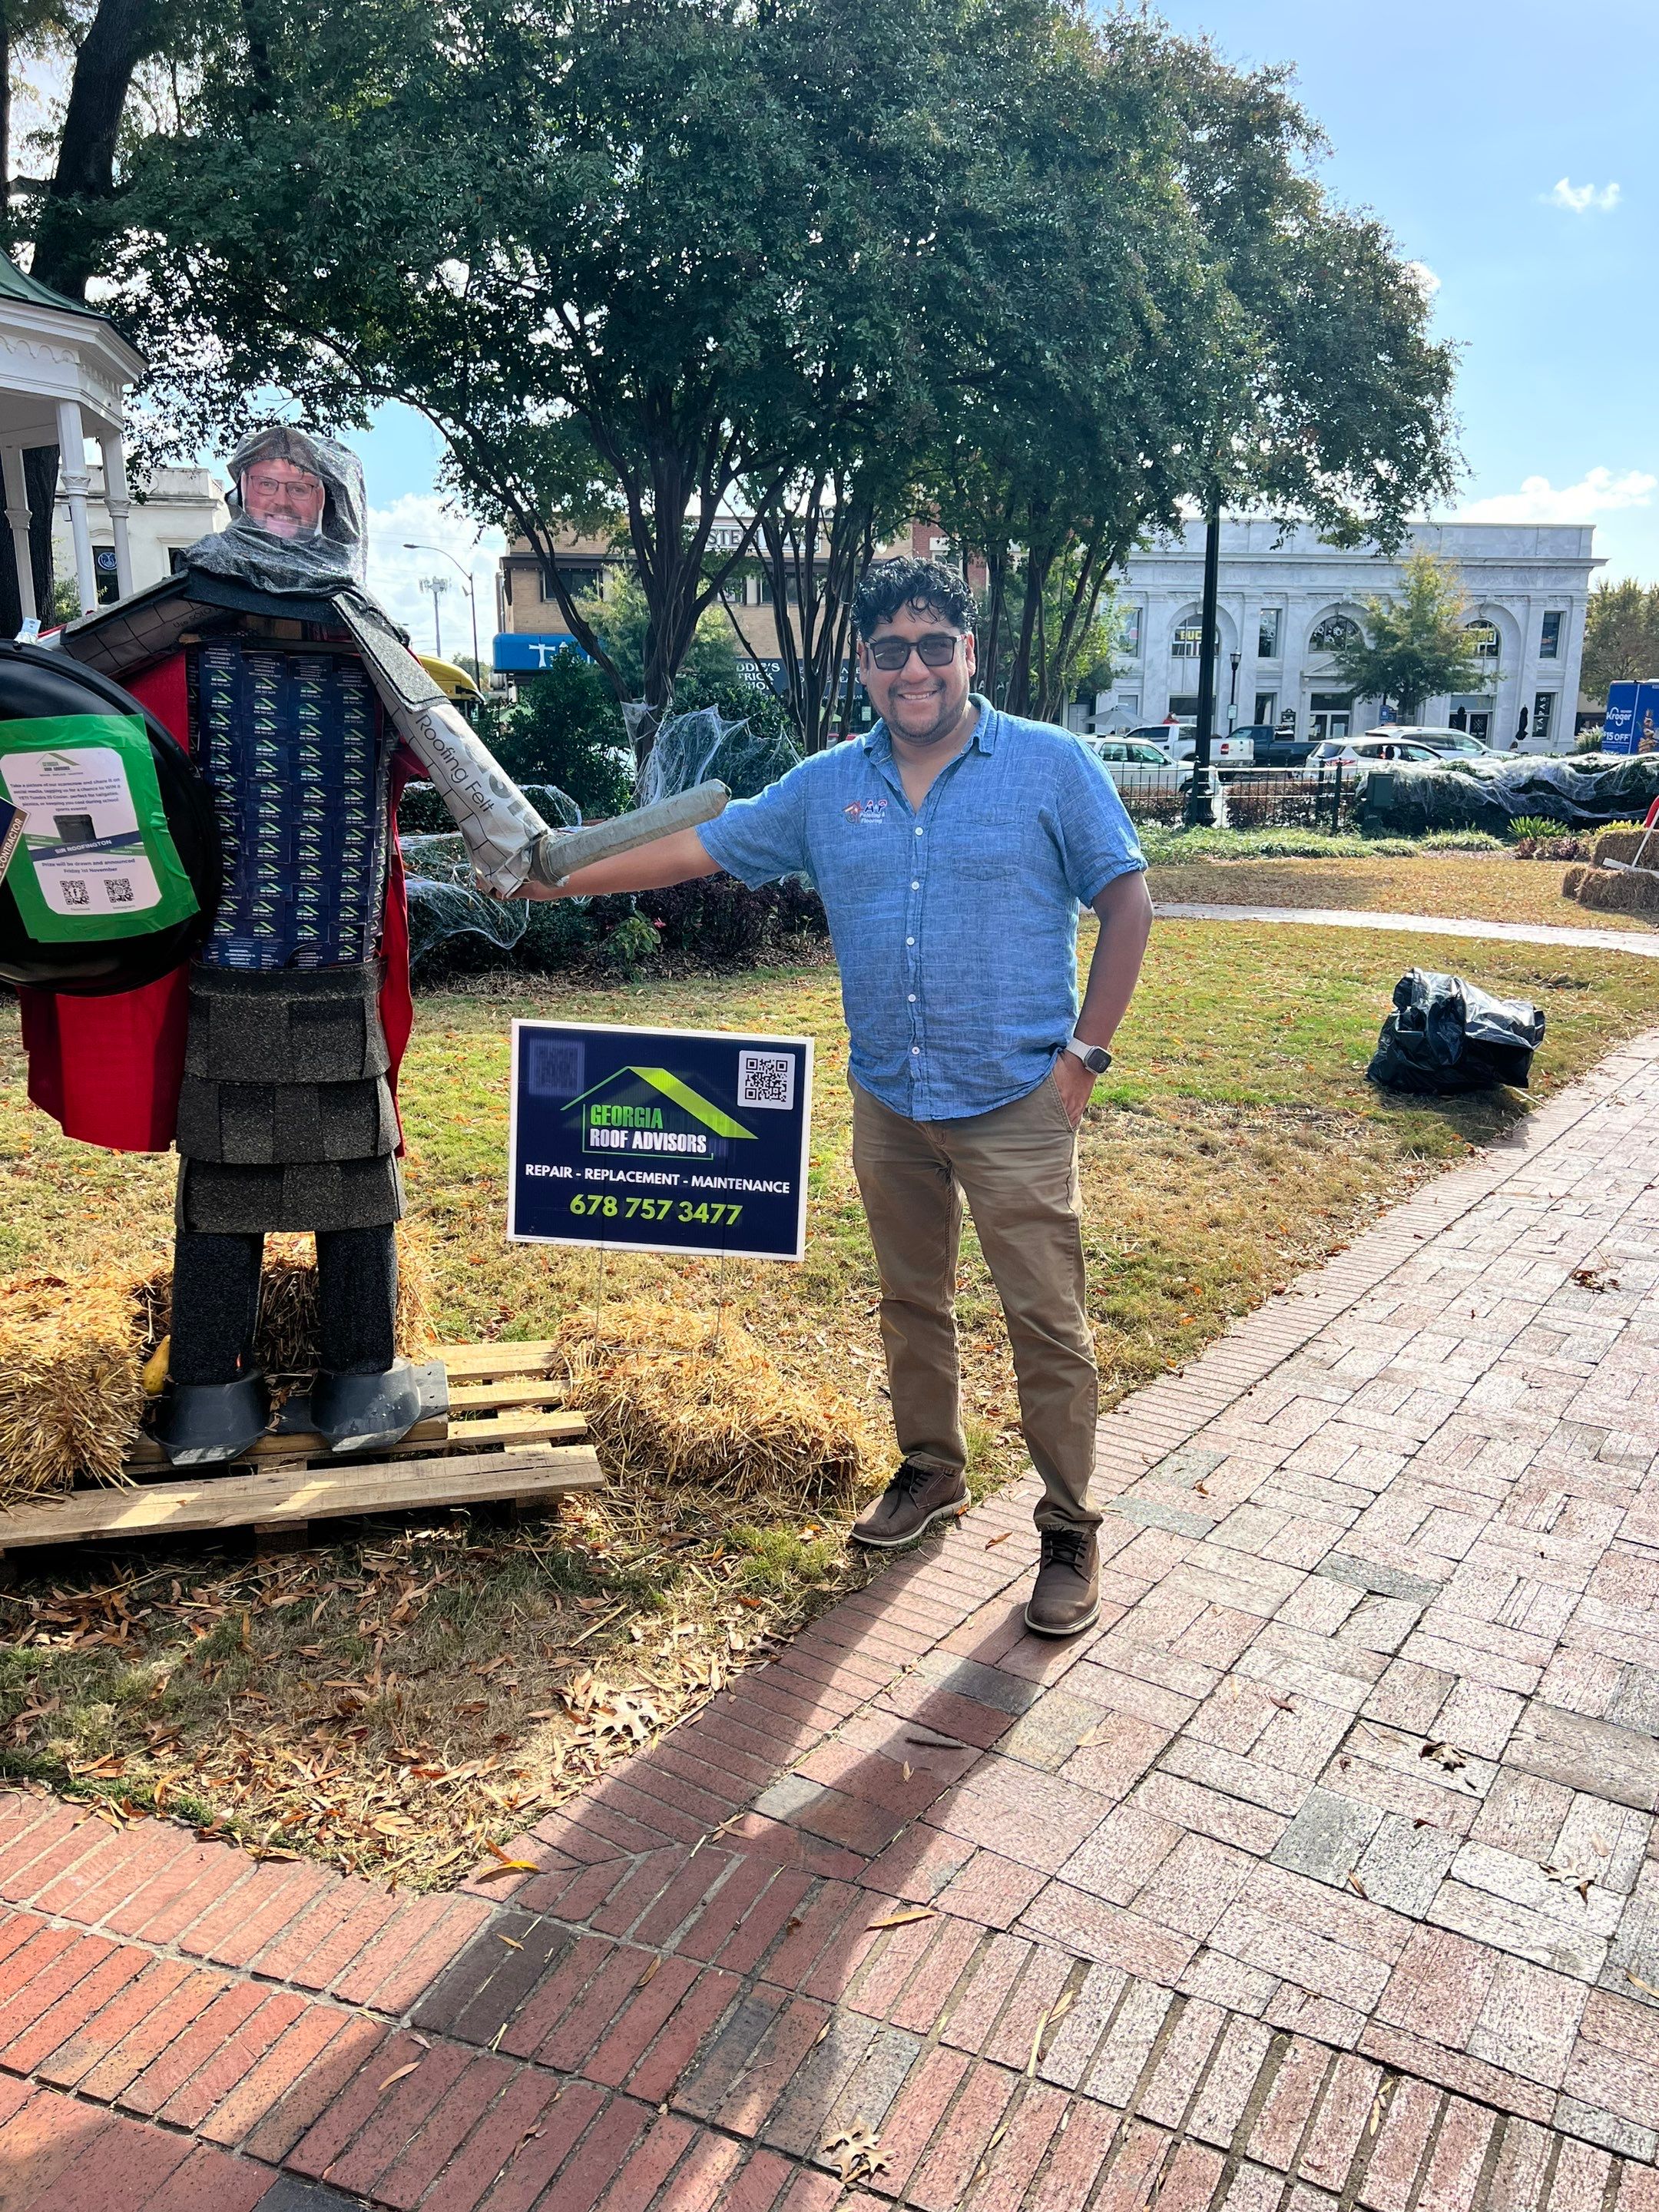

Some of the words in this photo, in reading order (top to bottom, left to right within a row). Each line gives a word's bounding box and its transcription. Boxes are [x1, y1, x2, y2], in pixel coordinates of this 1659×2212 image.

[1536, 697, 1546, 731] TAPAS
[416, 714, 469, 784] Roofing
[464, 780, 495, 813] Felt
[67, 839, 112, 852] ROOFINGTON
[590, 1104, 664, 1129] GEORGIA
[589, 1128, 628, 1148] ROOF
[631, 1131, 707, 1153] ADVISORS
[525, 1164, 572, 1179] REPAIR
[584, 1167, 680, 1187] REPLACEMENT
[691, 1176, 790, 1194] MAINTENANCE
[570, 1194, 618, 1217] 678
[624, 1197, 674, 1220] 757
[677, 1201, 743, 1226] 3477
